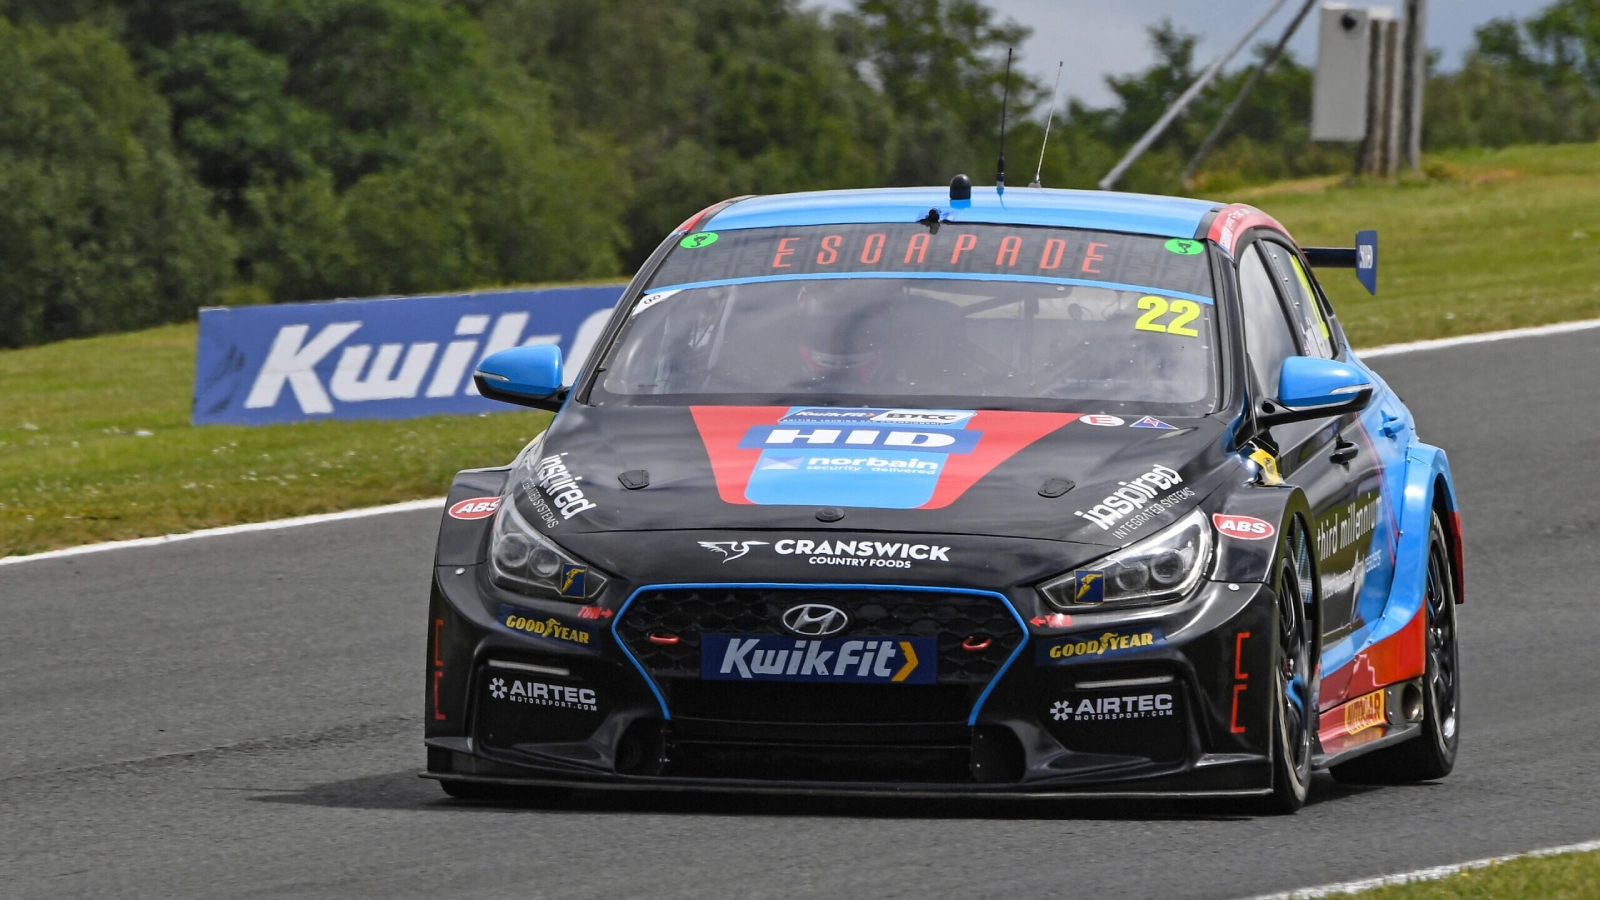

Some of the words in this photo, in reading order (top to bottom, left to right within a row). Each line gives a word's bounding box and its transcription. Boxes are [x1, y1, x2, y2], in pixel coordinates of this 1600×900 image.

[772, 233, 1109, 274] ESCAPADE
[1135, 295, 1201, 338] 22
[886, 412, 958, 421] BTCC
[765, 429, 956, 448] HID
[808, 457, 939, 470] norbain
[870, 466, 937, 475] delivered
[535, 452, 597, 520] inspired
[455, 501, 499, 514] ABS
[1073, 464, 1183, 531] inspired
[532, 498, 560, 529] SYSTEMS
[1112, 502, 1166, 540] INTEGRATED
[1159, 486, 1196, 508] SYSTEMS
[1219, 520, 1267, 534] ABS
[1317, 513, 1339, 562] third
[1340, 492, 1383, 550] millennium
[774, 539, 951, 562] CRANSWICK
[808, 556, 867, 567] COUNTRY
[869, 559, 912, 569] FOODS
[510, 680, 597, 705] AIRTEC
[509, 695, 598, 712] MOTORSPORT.COM
[1074, 694, 1173, 715] AIRTEC
[1074, 709, 1174, 721] MOTORSPORT.COM
